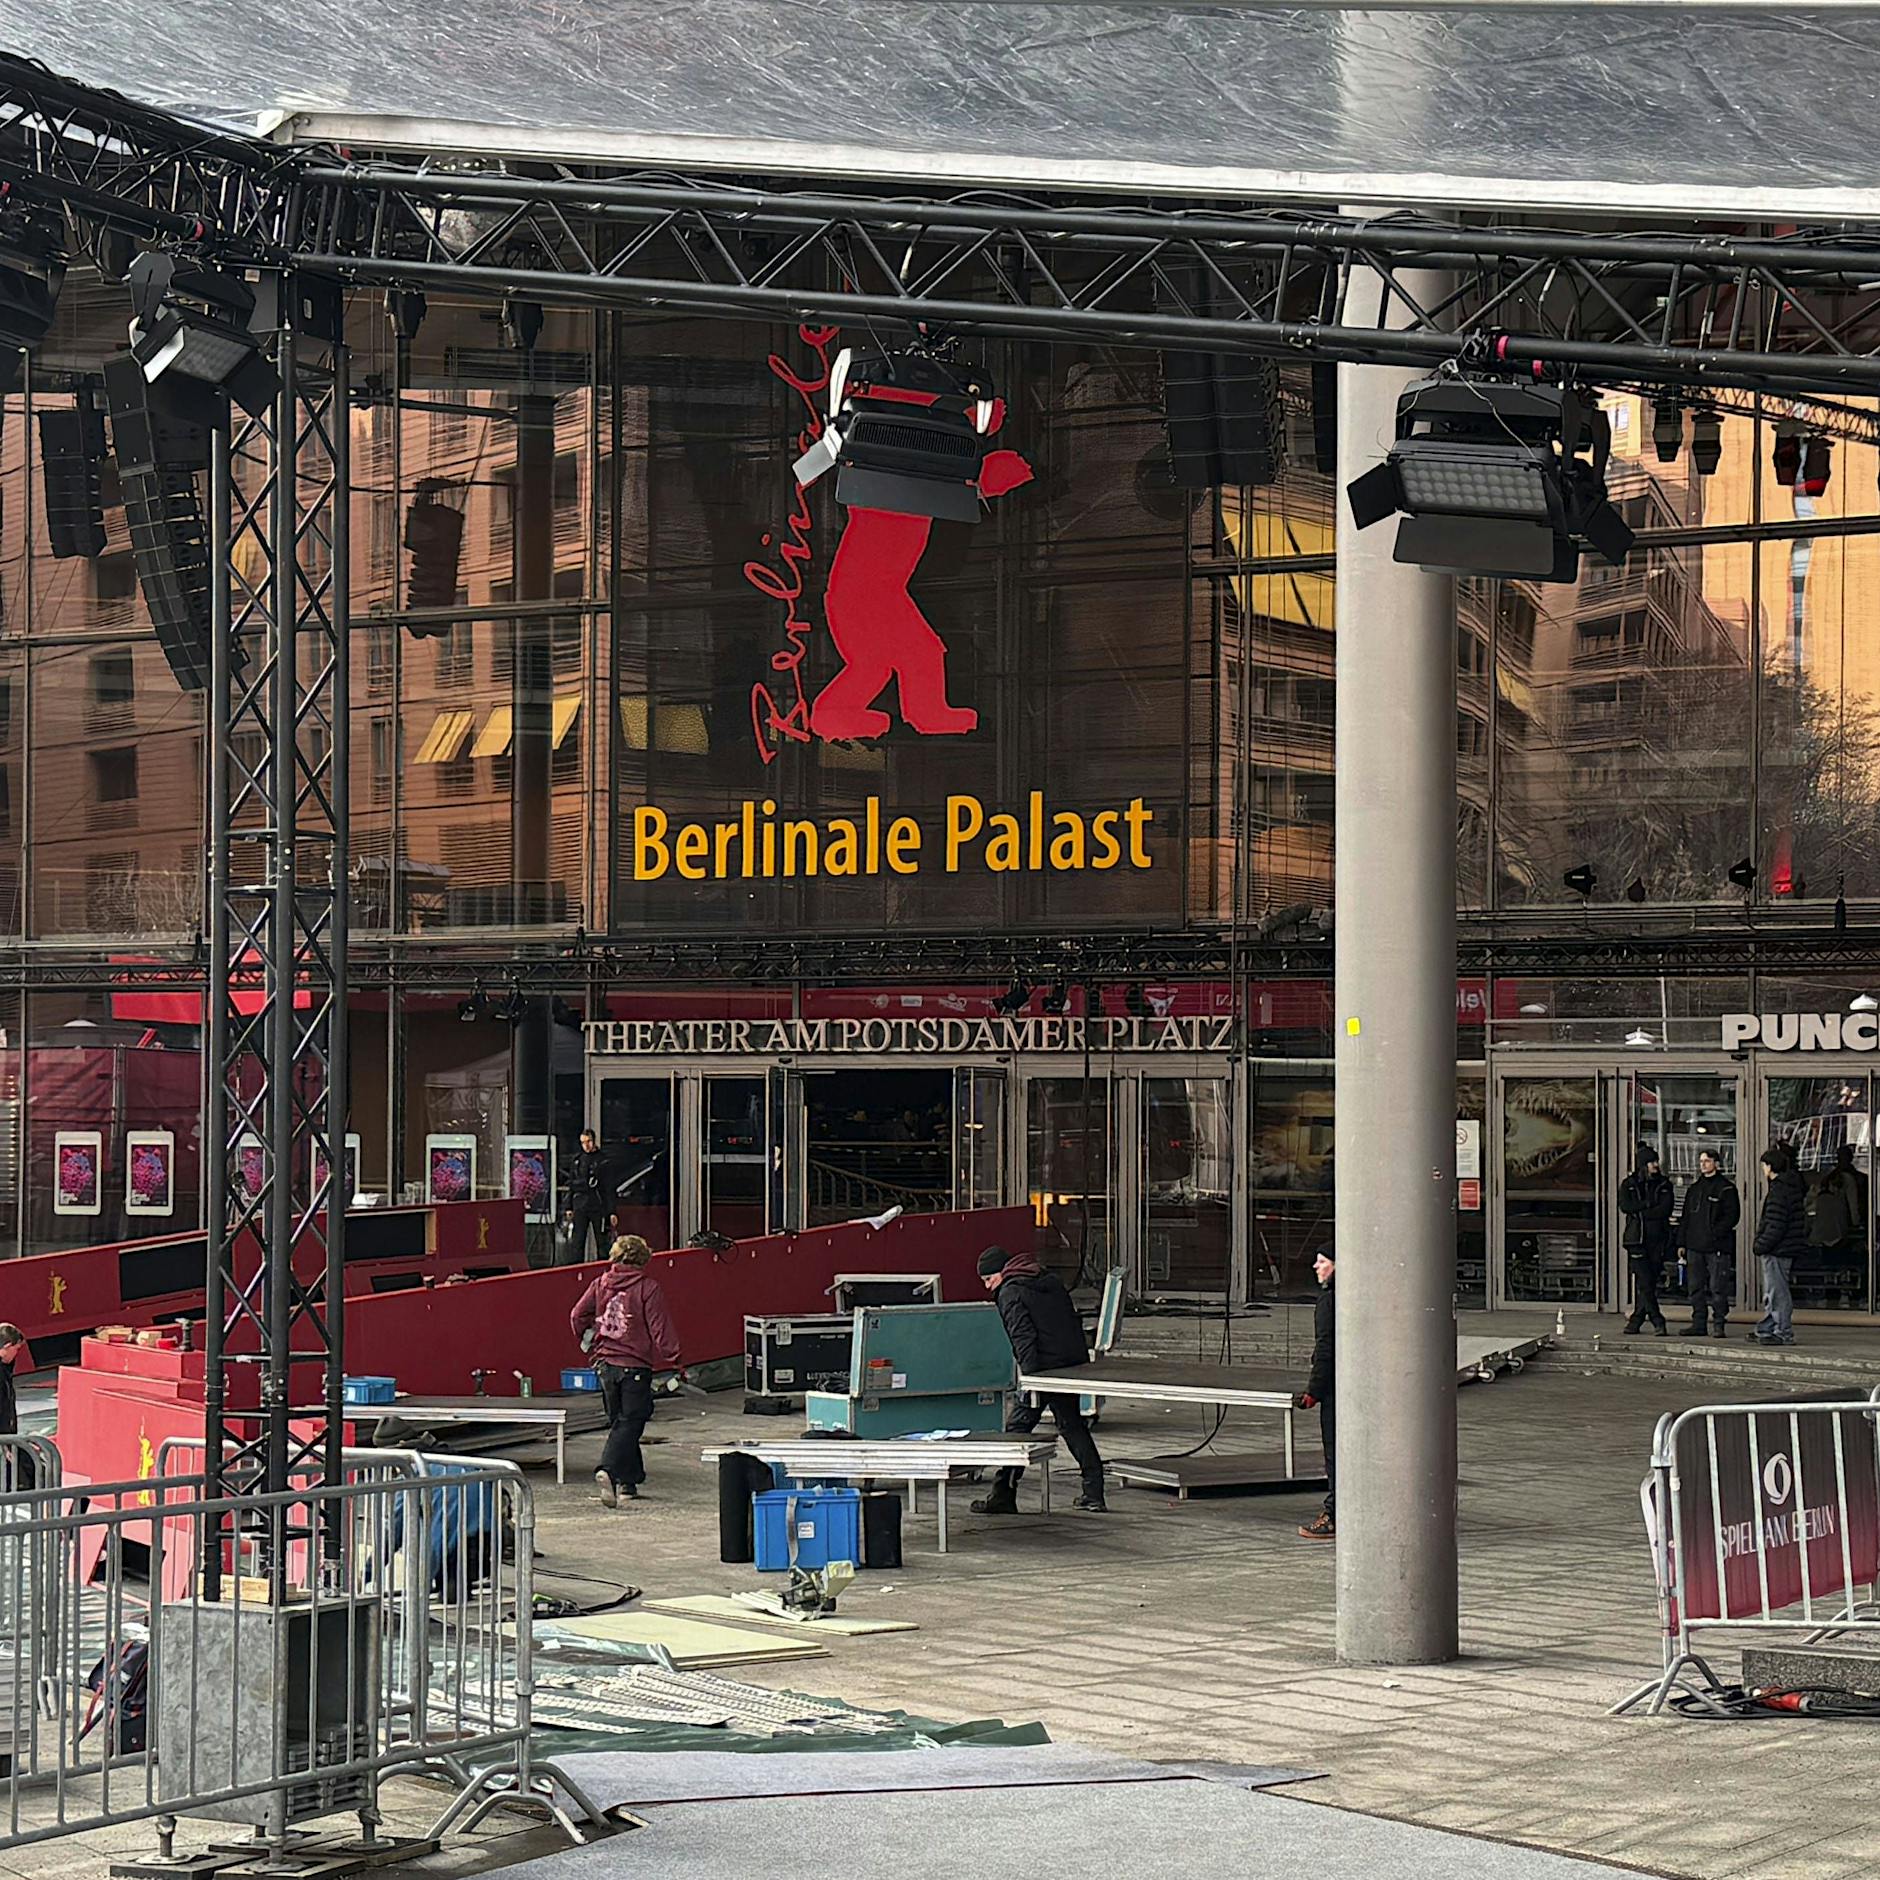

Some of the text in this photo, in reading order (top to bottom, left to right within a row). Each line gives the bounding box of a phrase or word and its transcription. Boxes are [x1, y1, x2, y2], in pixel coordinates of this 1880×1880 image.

[633, 790, 1154, 881] Berlinale Palast
[581, 1015, 1234, 1052] THEATER AM POTSDAMER PLATZ
[1721, 1012, 1880, 1051] PUNC
[1720, 1513, 1790, 1561] SPIELANK
